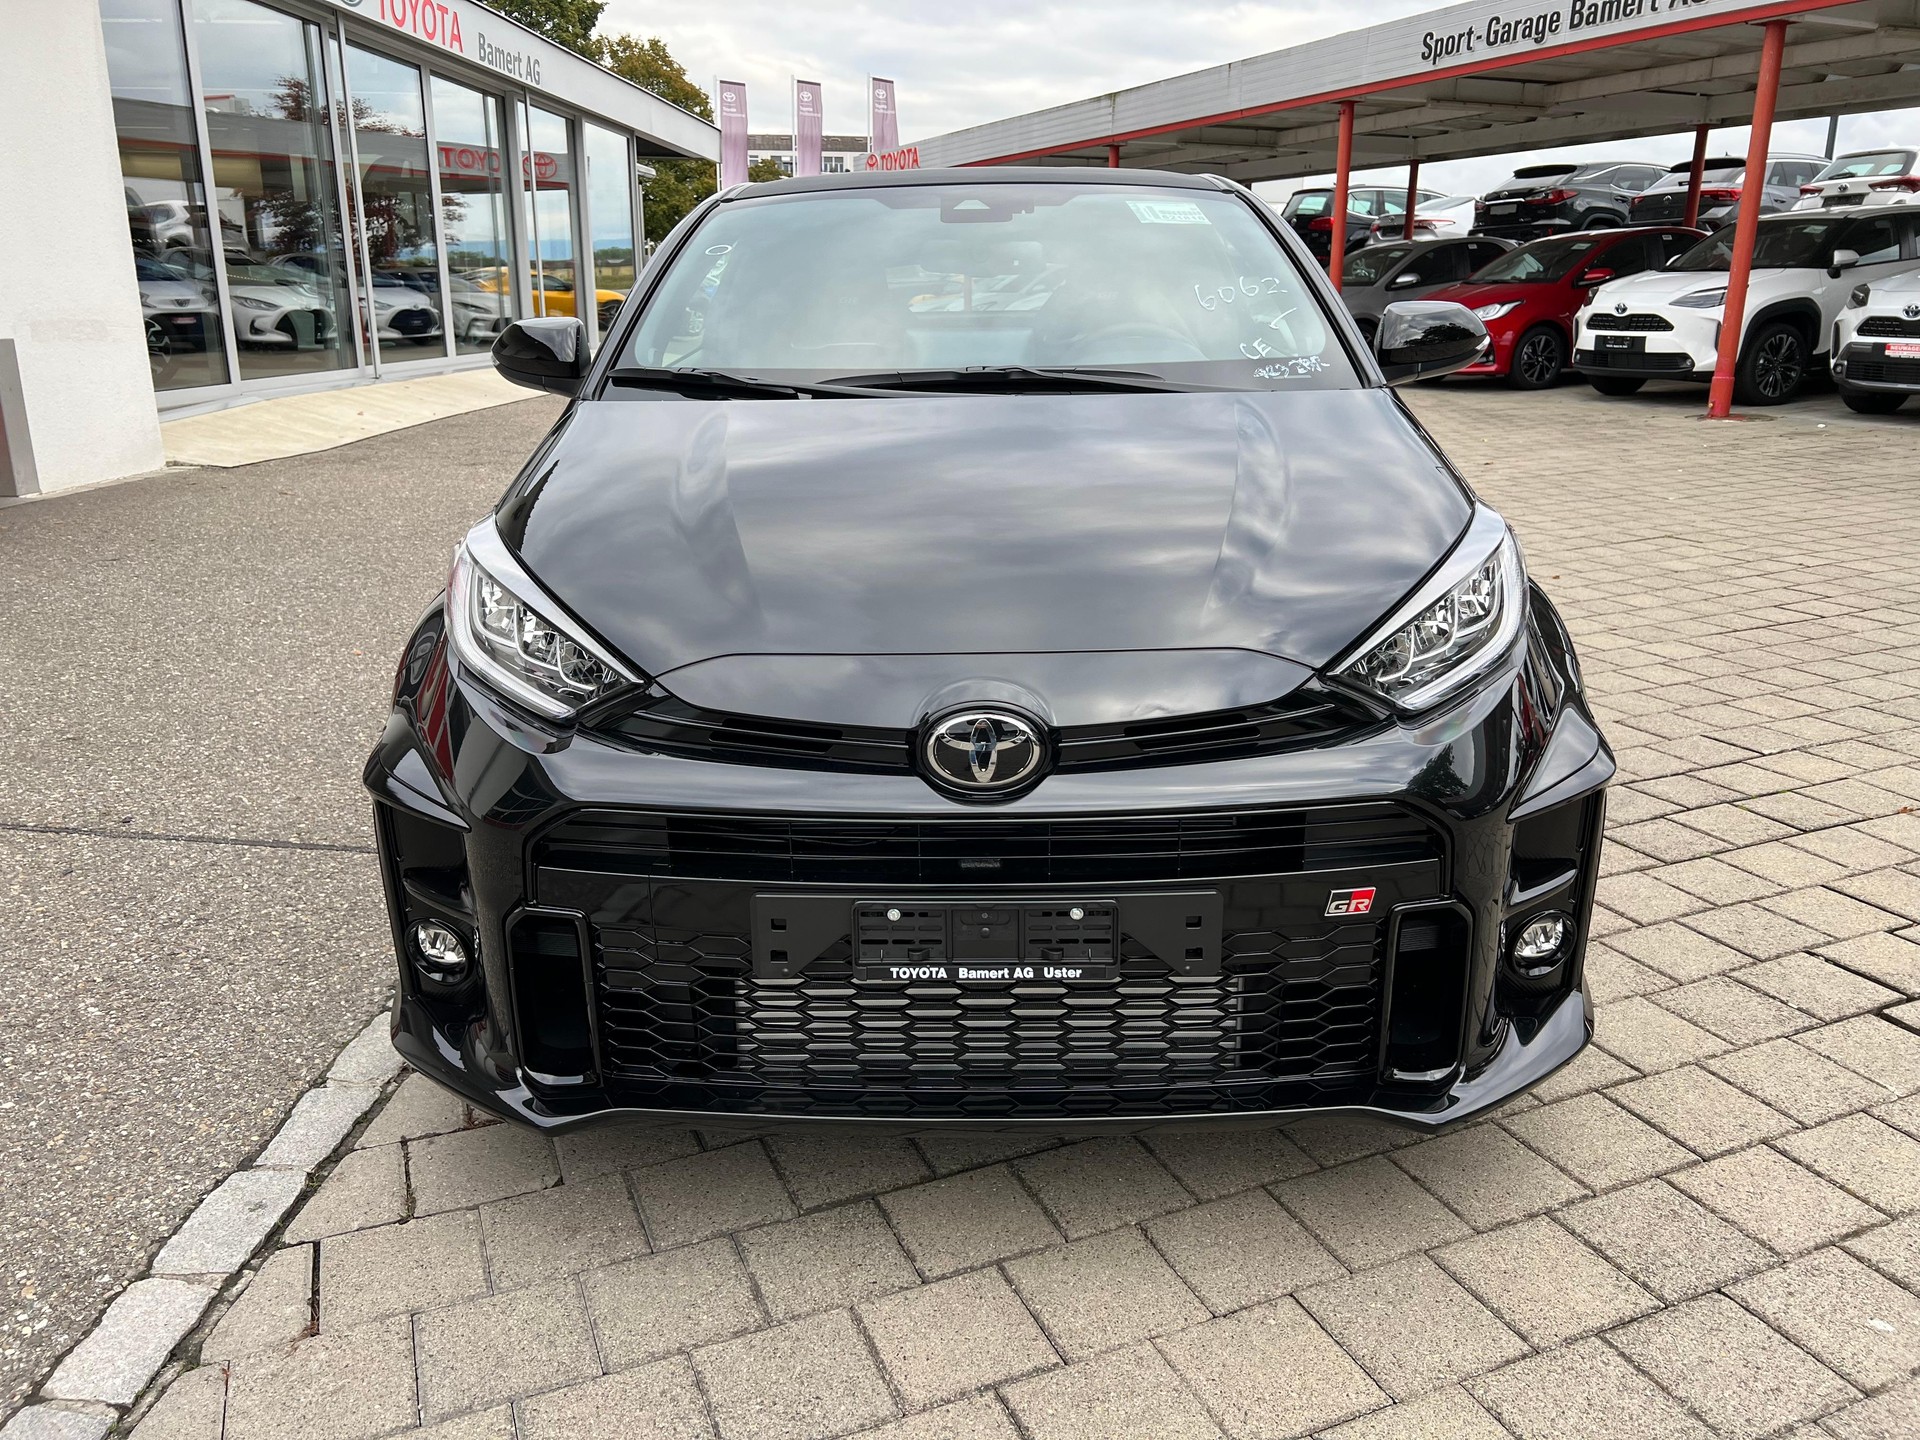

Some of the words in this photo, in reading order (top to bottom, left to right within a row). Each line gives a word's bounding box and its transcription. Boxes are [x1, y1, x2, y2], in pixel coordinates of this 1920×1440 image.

[478, 32, 523, 79] Bamert
[525, 55, 541, 86] AG
[880, 146, 920, 171] TOYOTA
[1328, 898, 1370, 914] GR
[890, 967, 948, 979] TOYOTA
[958, 967, 1010, 979] Bamert
[1013, 967, 1035, 979] AG
[1043, 967, 1082, 979] Uster
